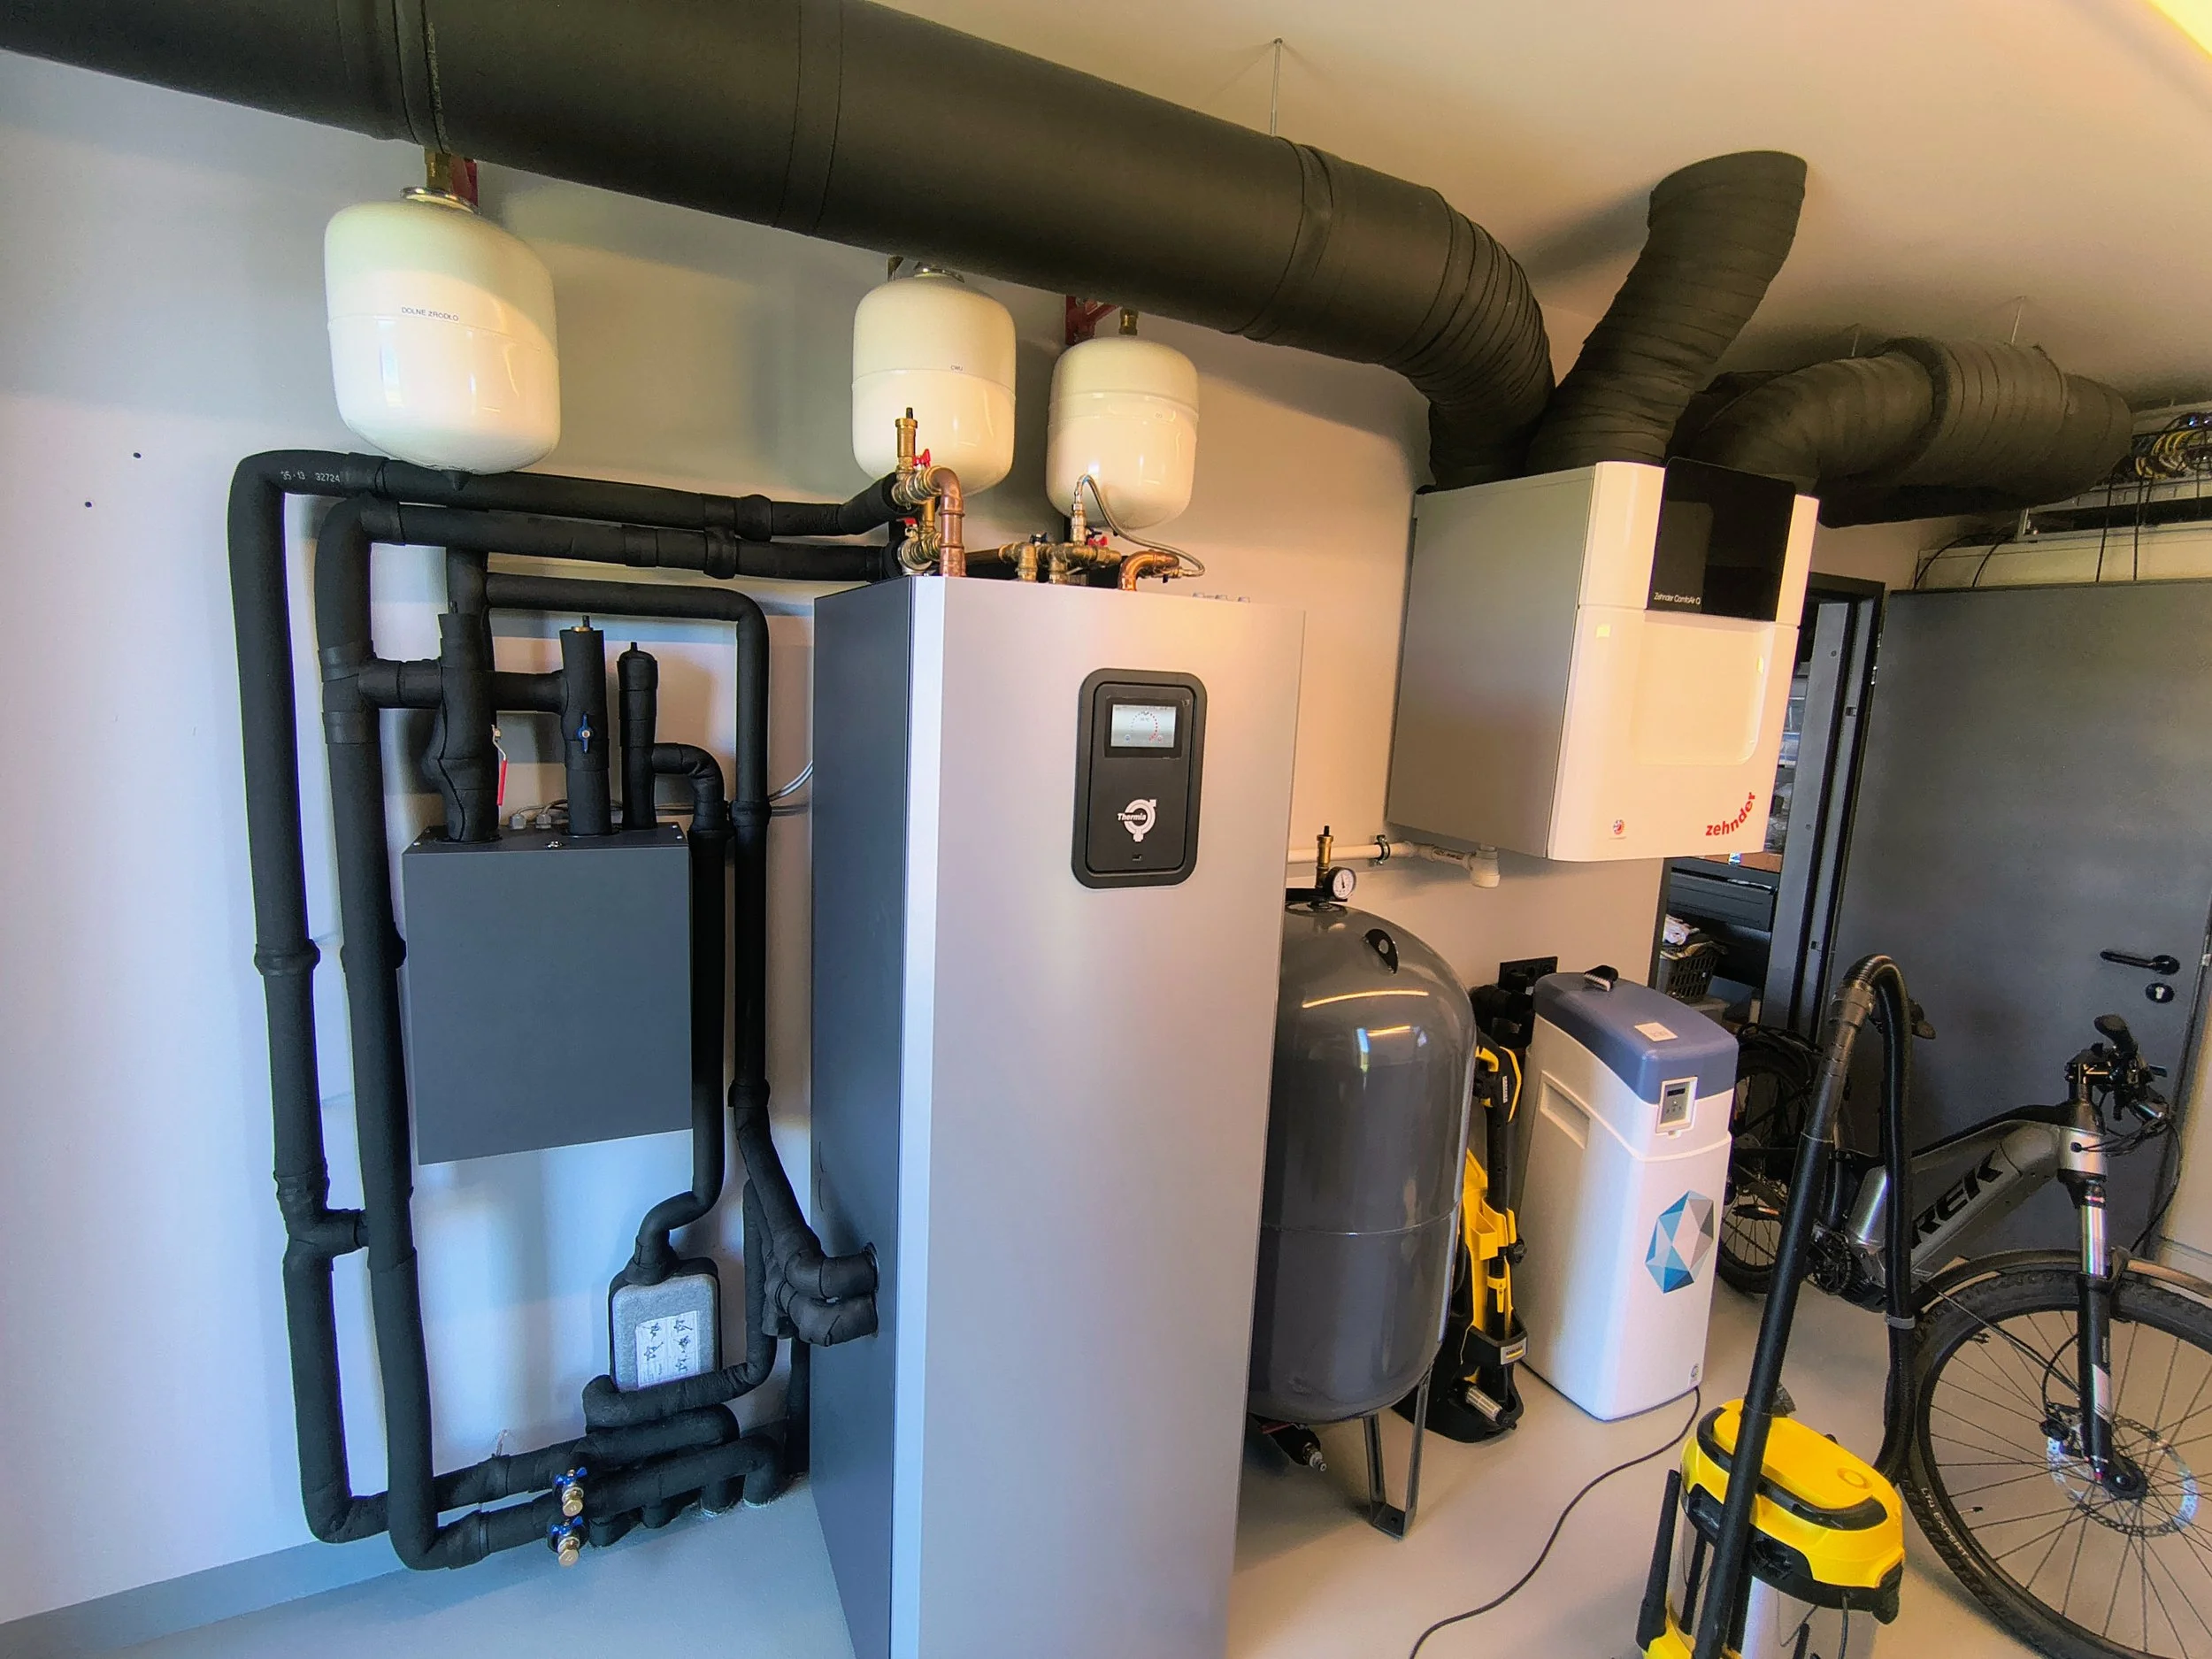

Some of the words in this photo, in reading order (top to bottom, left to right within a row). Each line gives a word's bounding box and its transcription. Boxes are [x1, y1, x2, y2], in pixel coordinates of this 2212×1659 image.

[401, 306, 426, 316] DOLNE
[1117, 812, 1147, 821] Thermia
[1705, 791, 1756, 836] zehnder
[1911, 1149, 2004, 1250] REK
[1933, 1511, 1970, 1556] EXPERT
